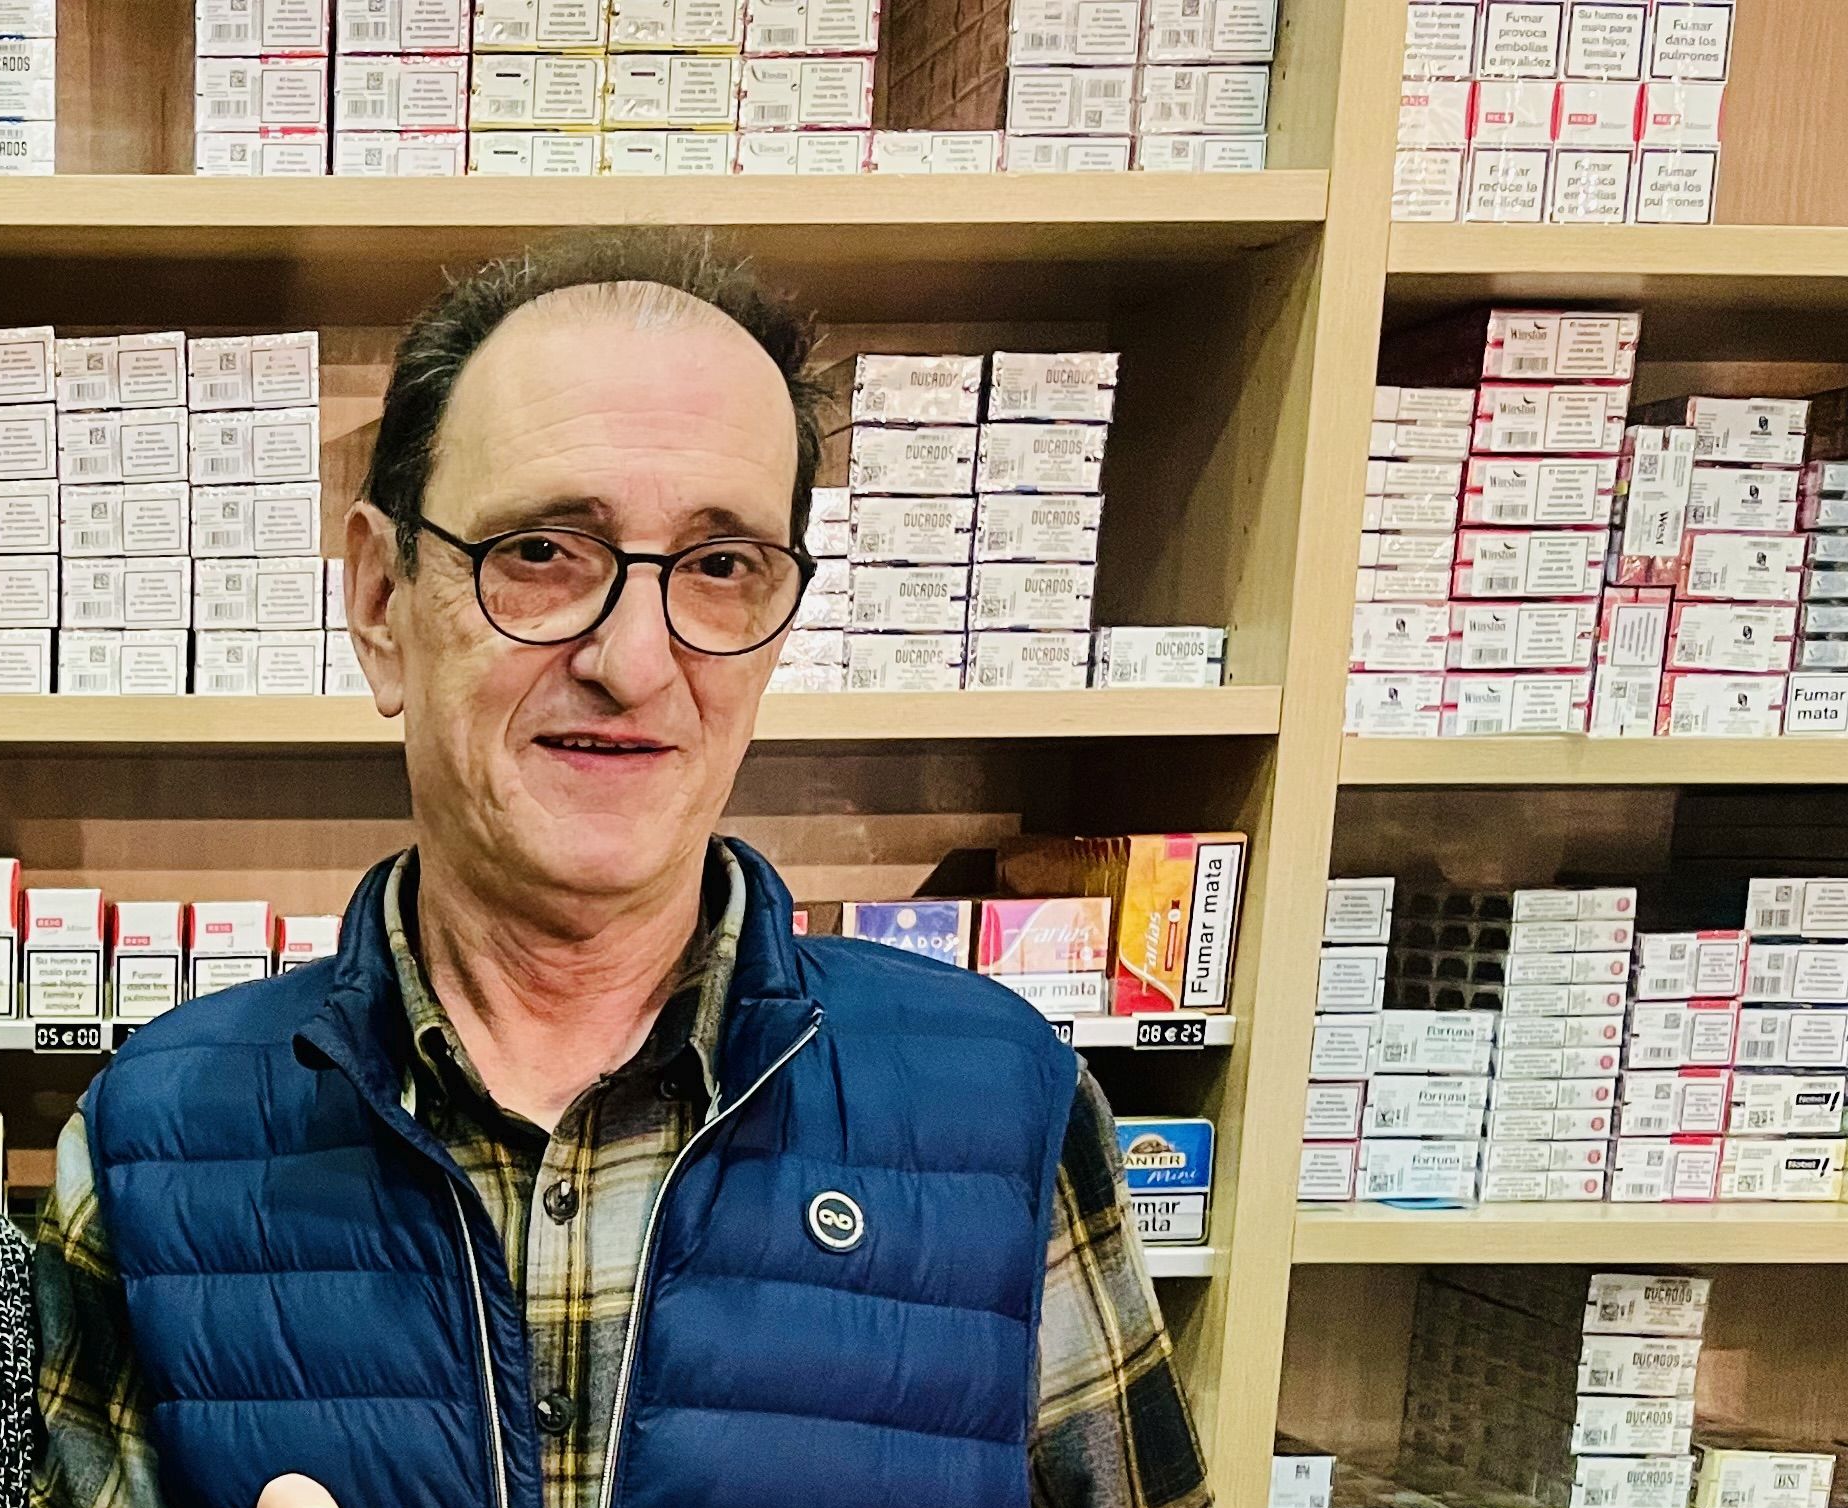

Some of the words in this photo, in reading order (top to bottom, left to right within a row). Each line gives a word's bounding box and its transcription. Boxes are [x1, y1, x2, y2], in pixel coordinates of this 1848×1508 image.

[1506, 12, 1542, 23] Fumar
[1499, 27, 1546, 39] provoca
[1033, 439, 1082, 455] DUCADOS
[899, 583, 947, 598] DUCADOS
[1155, 642, 1204, 657] DUCADOS
[1795, 688, 1846, 705] Fumar
[1798, 706, 1839, 722] mata
[1203, 857, 1223, 914] mata
[1191, 919, 1221, 996] Fumar
[1052, 981, 1097, 999] mata
[1122, 1153, 1181, 1166] ANTER
[1627, 1471, 1673, 1486] DUCADOS
